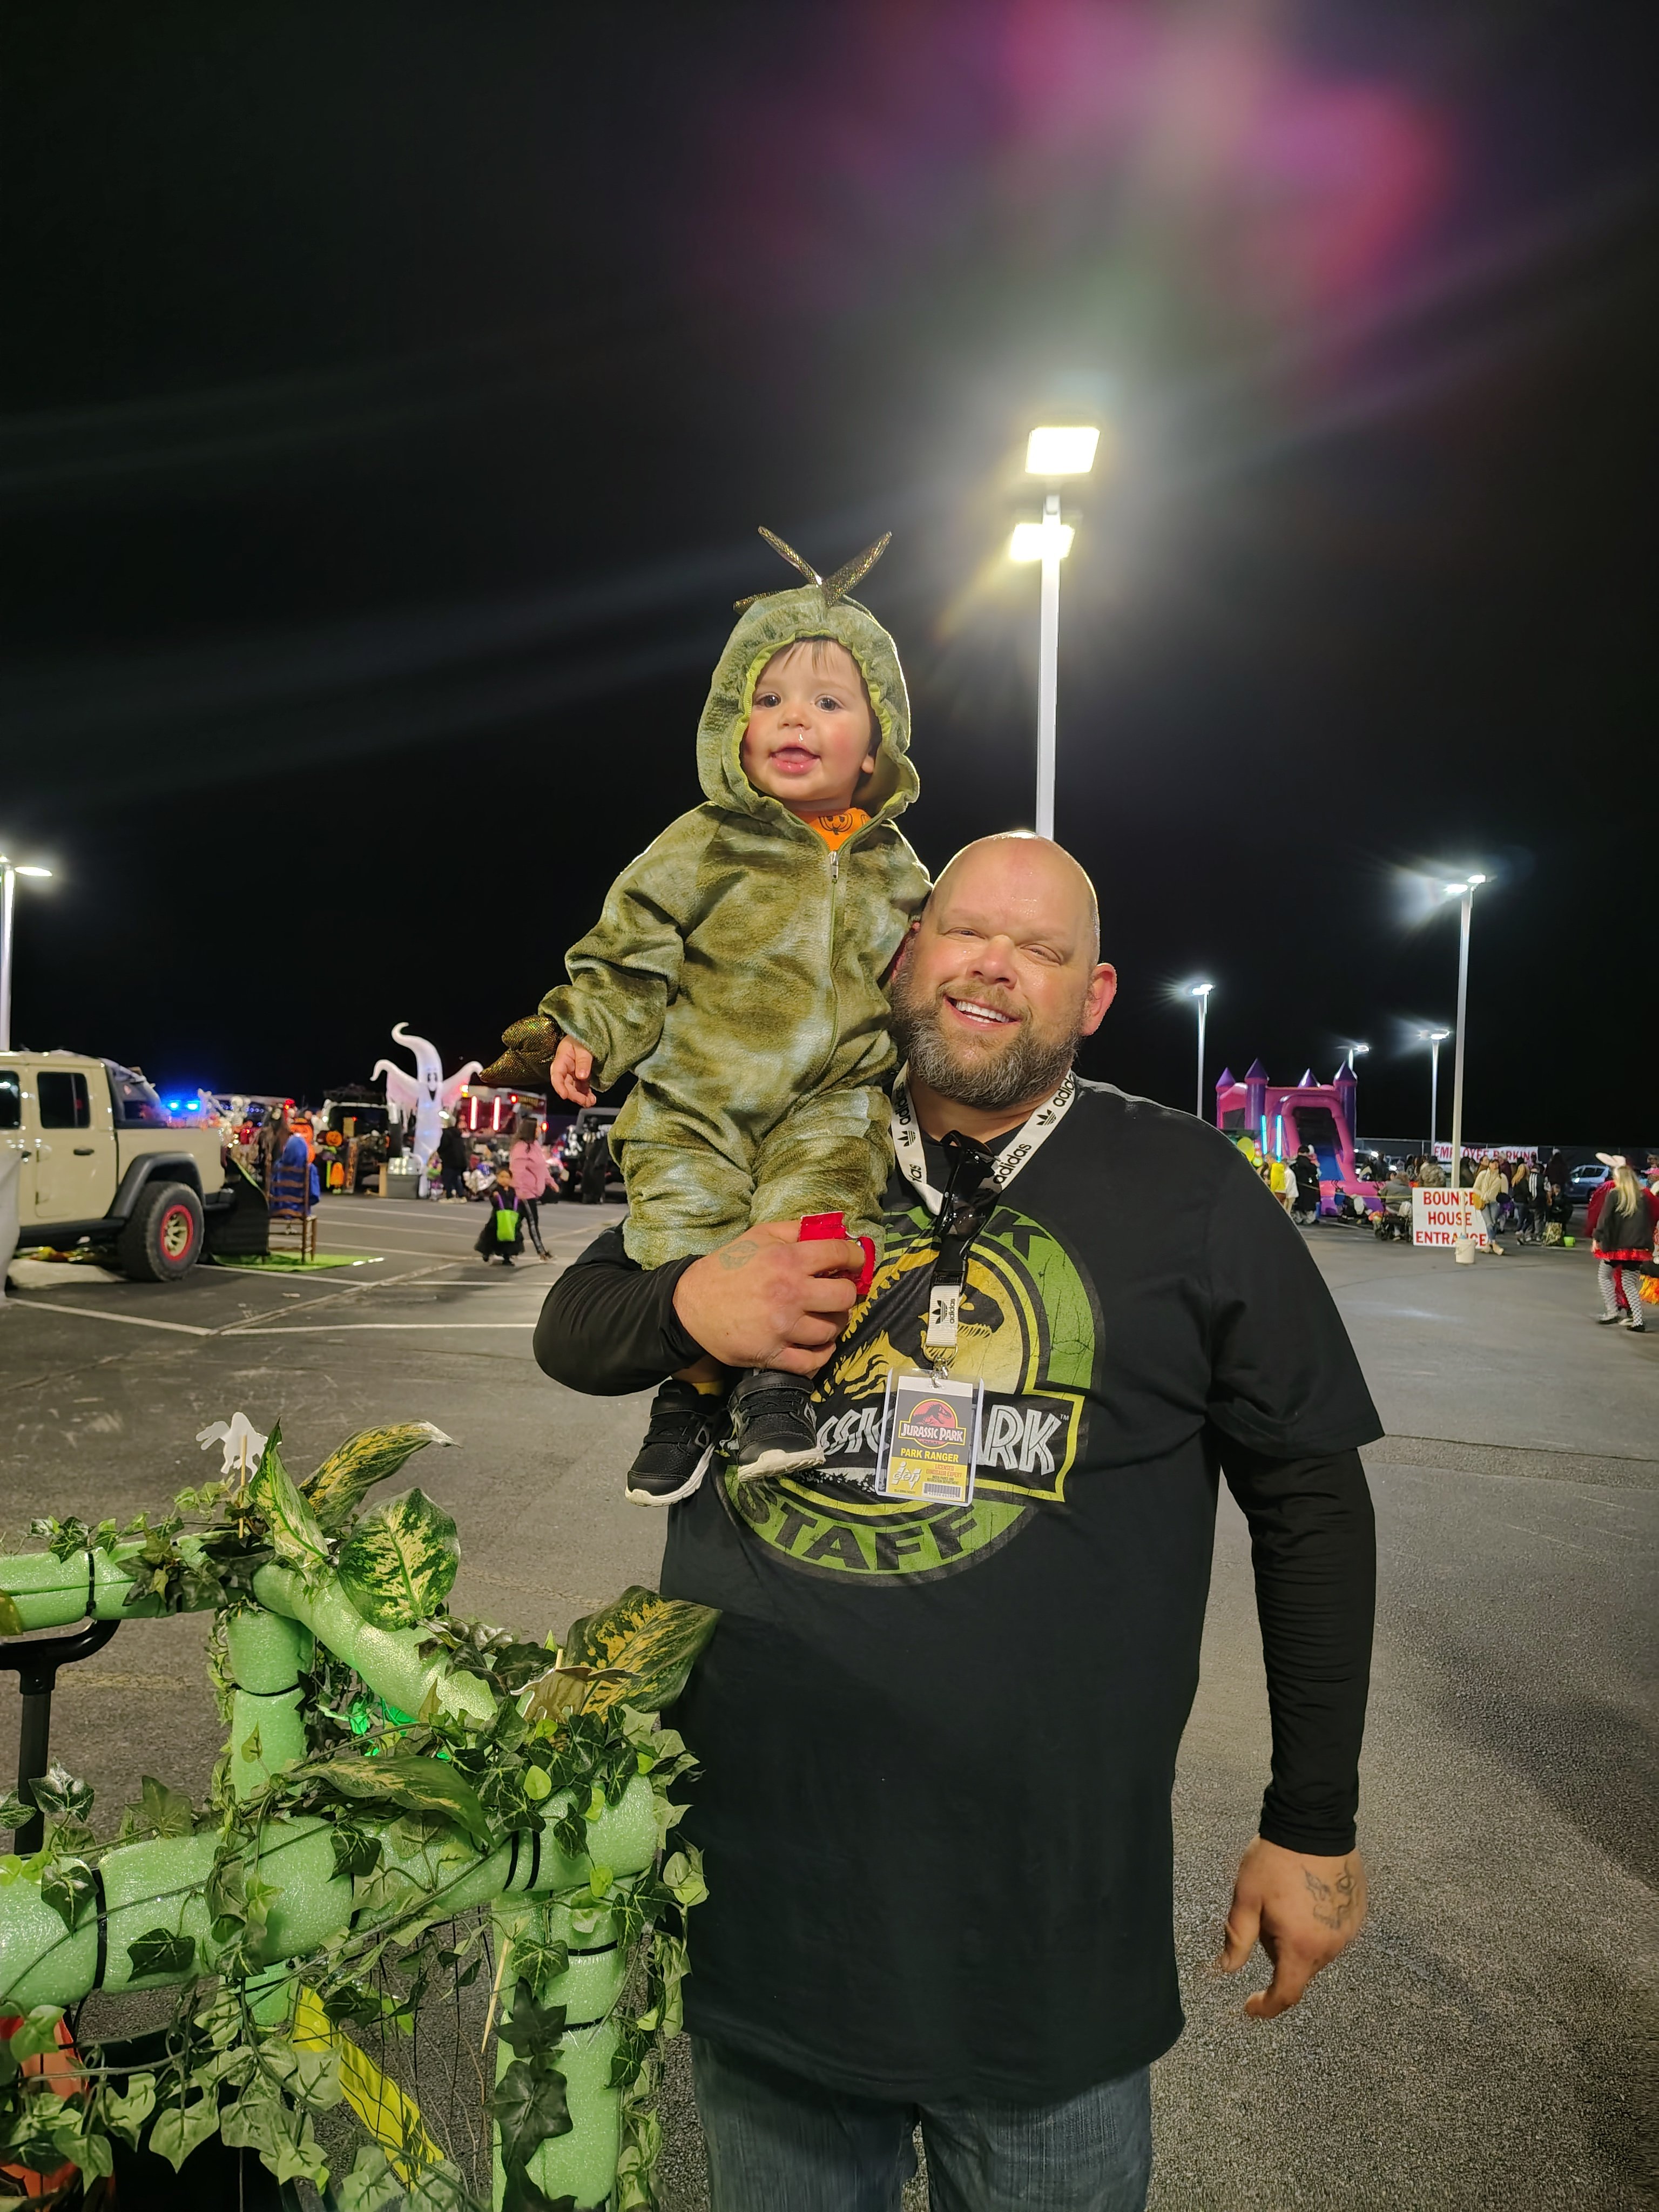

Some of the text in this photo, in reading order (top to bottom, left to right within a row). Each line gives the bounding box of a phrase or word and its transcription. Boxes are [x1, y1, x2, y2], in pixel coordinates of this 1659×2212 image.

[993, 1144, 1031, 1184] adidas
[1428, 1211, 1472, 1226] HOUSE
[901, 1423, 963, 1442] JURASSIC PARK
[900, 1448, 959, 1462] PARK RANGER
